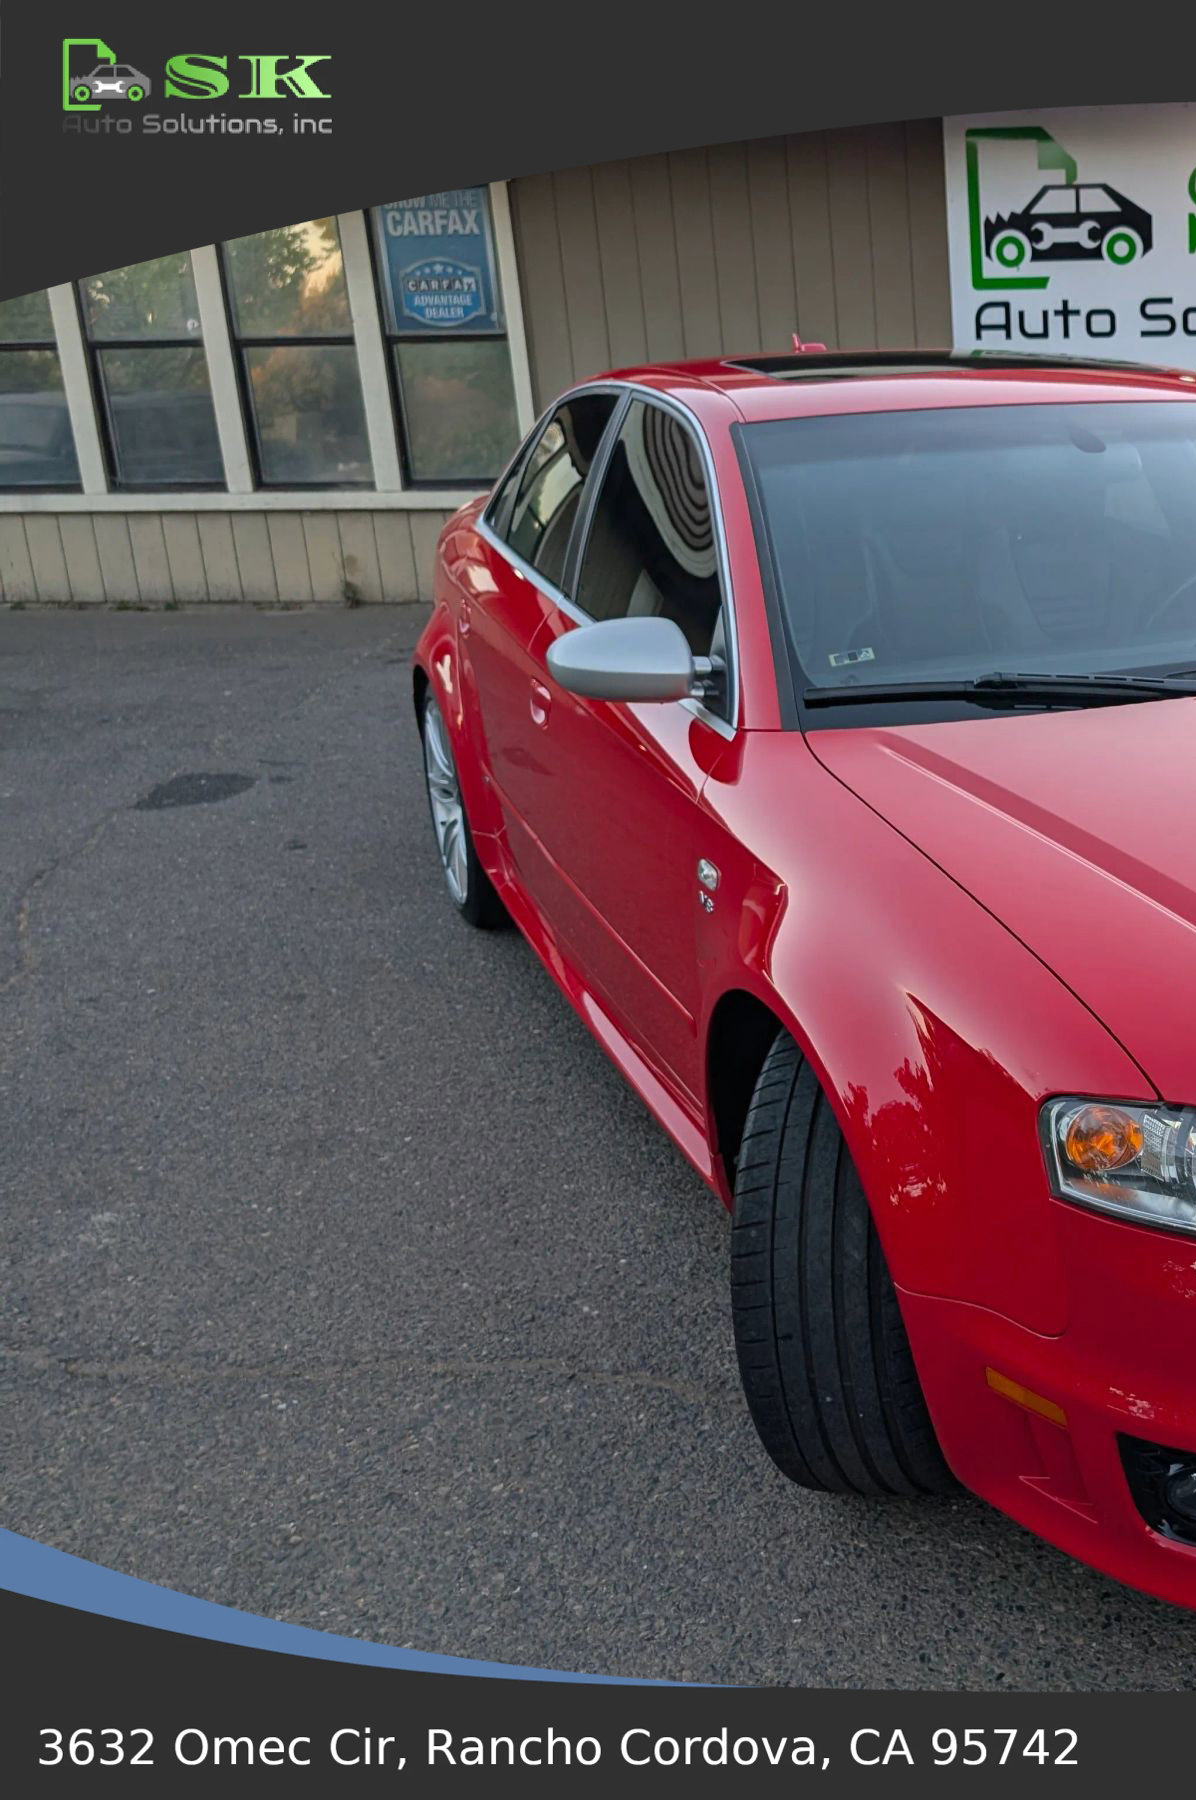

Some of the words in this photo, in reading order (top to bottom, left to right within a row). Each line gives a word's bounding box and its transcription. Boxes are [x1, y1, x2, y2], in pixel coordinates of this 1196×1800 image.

[386, 209, 481, 237] CARFAX
[413, 293, 473, 307] ADVANTAGE
[424, 306, 465, 319] DEALER
[974, 300, 1118, 341] Auto
